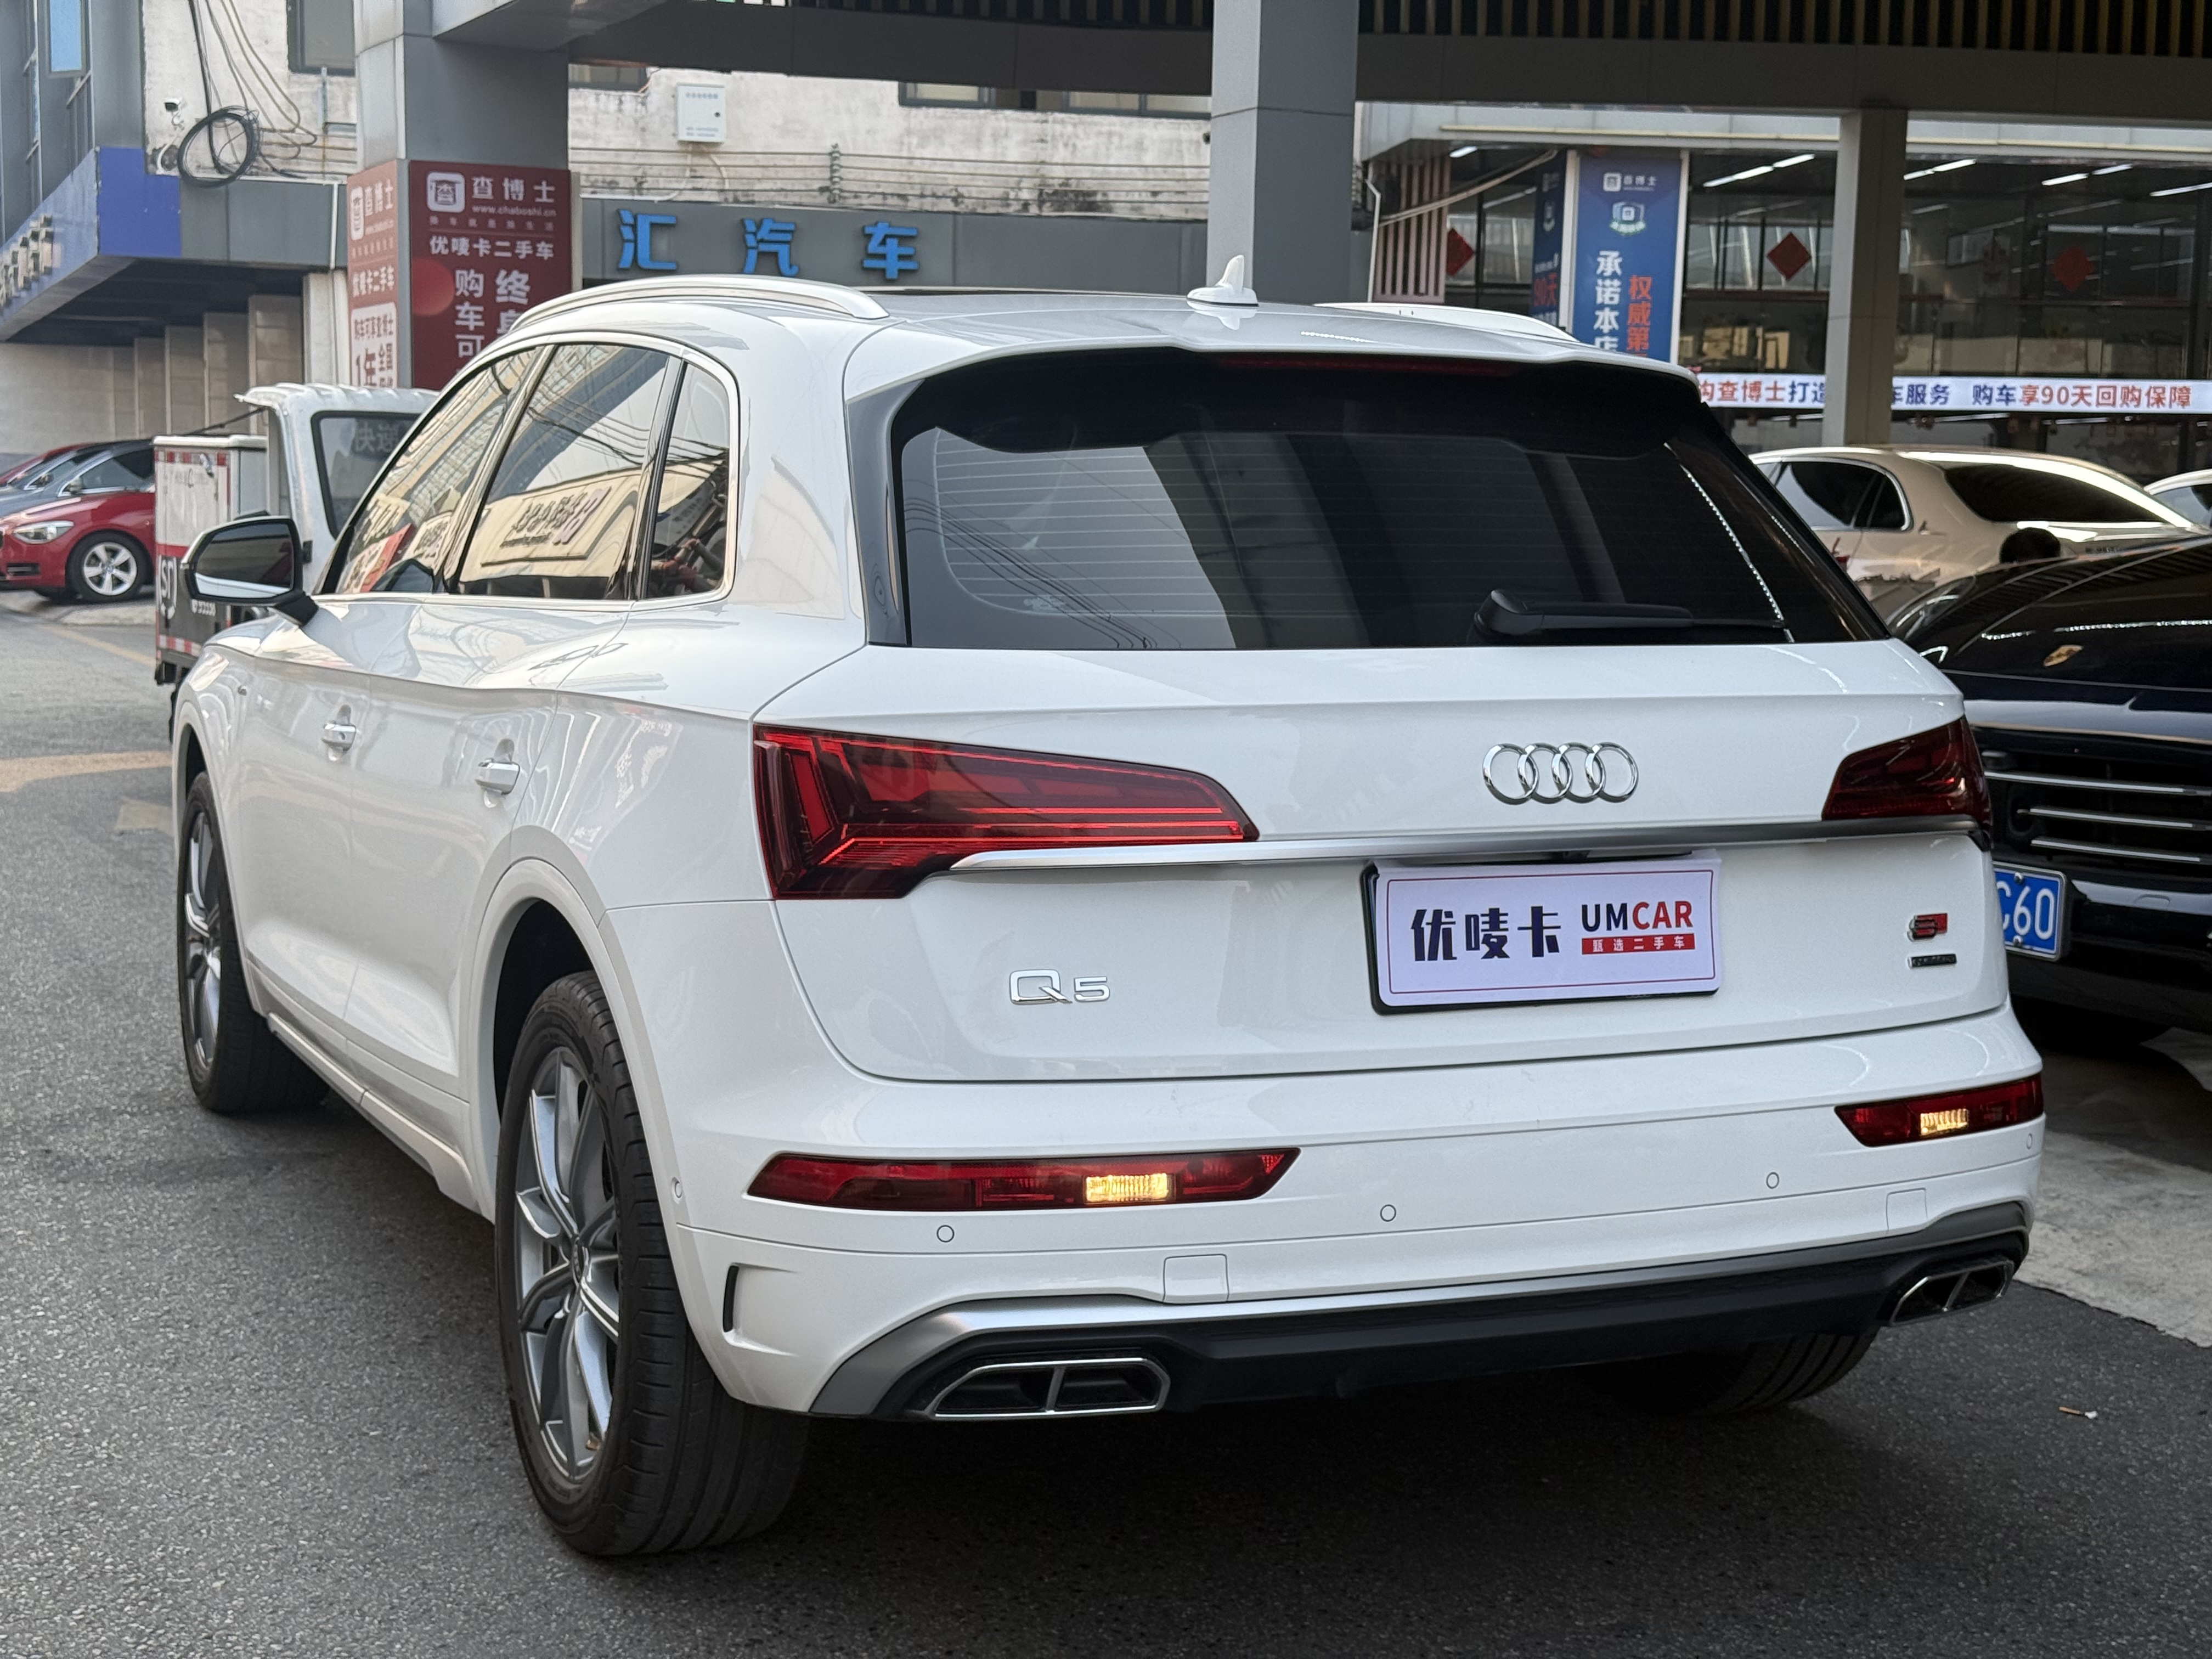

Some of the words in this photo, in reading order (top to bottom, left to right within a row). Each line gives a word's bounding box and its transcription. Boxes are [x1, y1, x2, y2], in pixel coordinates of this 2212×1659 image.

[472, 176, 556, 203] 查博士
[430, 236, 554, 260] 优唛卡二手车
[1594, 251, 1622, 350] 承诺本店
[1627, 275, 1652, 356] 权威第
[1973, 384, 2192, 408] 购车享90天回购保障
[1581, 900, 1694, 933] UMCAR
[1410, 906, 1561, 962] 优唛卡
[1592, 935, 1685, 953] 甄选二手车
[1009, 969, 1111, 1005] Q5
